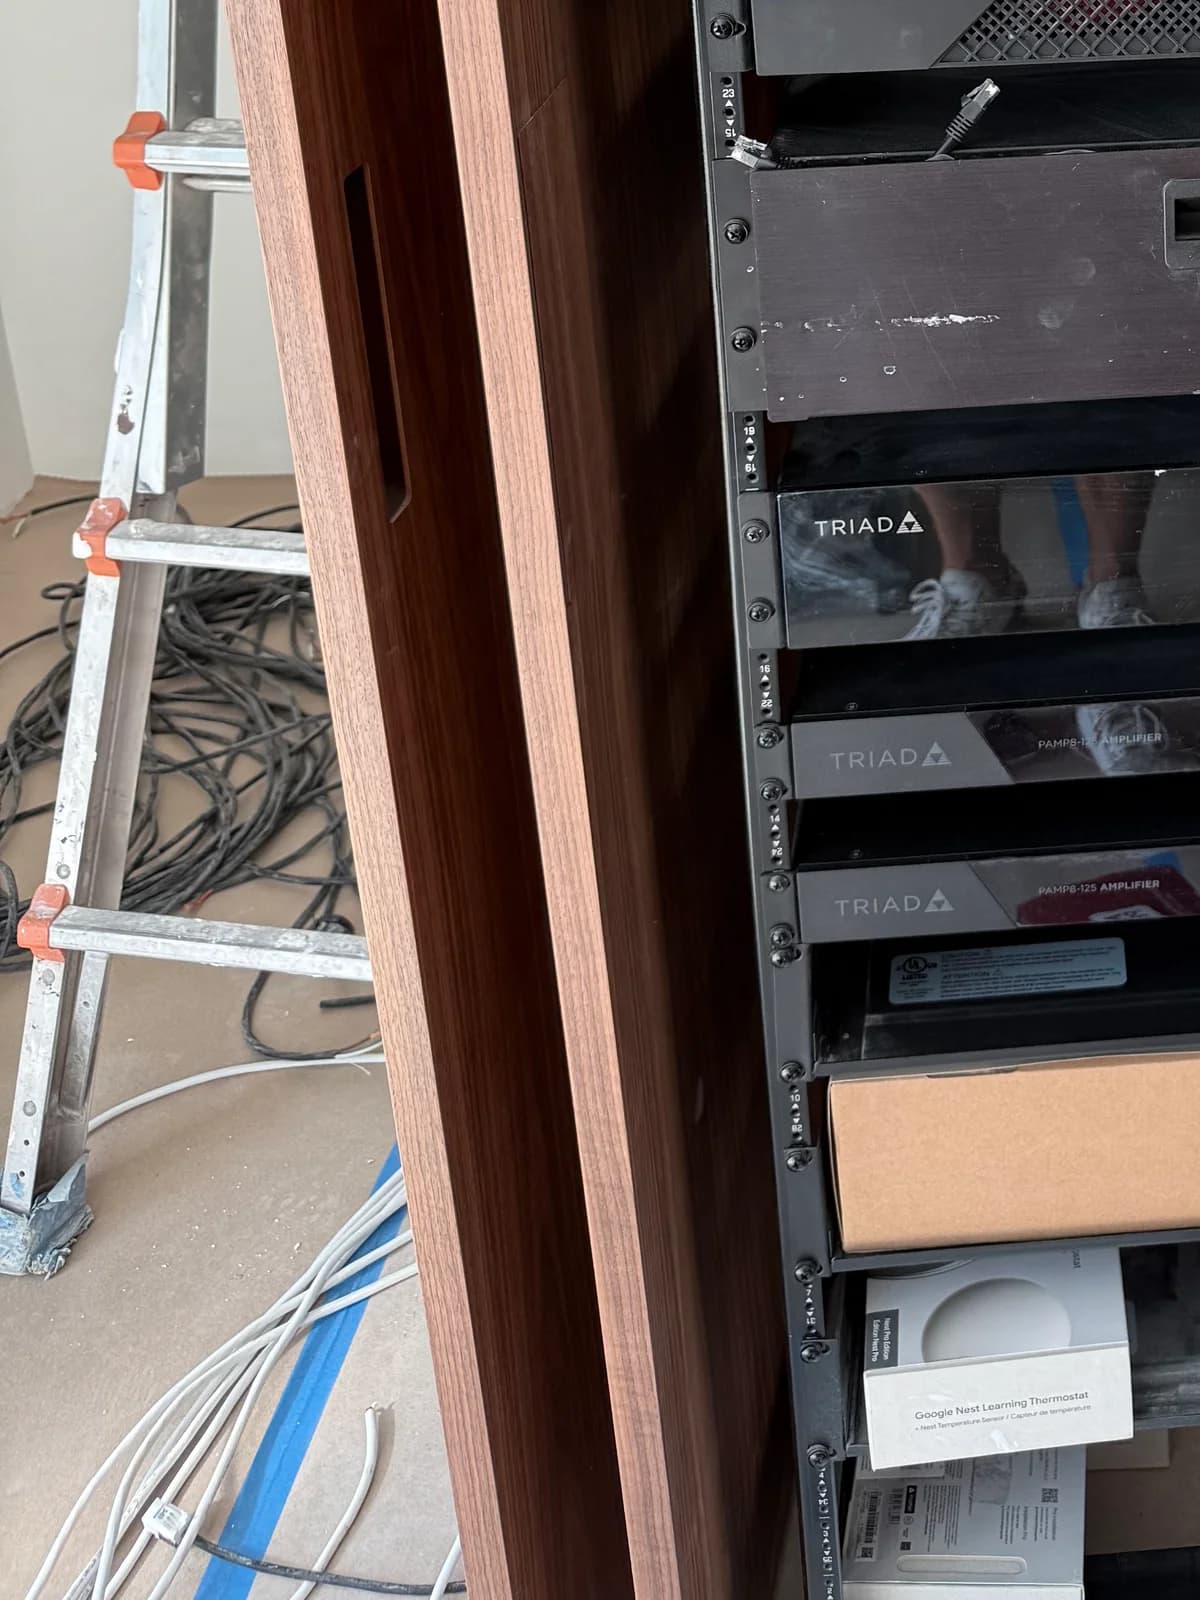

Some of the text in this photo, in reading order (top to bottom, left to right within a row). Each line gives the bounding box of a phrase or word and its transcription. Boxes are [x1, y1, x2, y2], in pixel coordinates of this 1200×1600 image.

[721, 89, 734, 98] 23
[814, 516, 894, 537] TRIAD
[1101, 732, 1162, 745] AMPLIFIER
[830, 748, 918, 769] TRIAD
[1038, 879, 1160, 895] PAMP8-125 AMPLIFIER
[834, 895, 920, 916] TRIAD
[915, 1391, 1089, 1420] Google Nest Learning Thermostat
